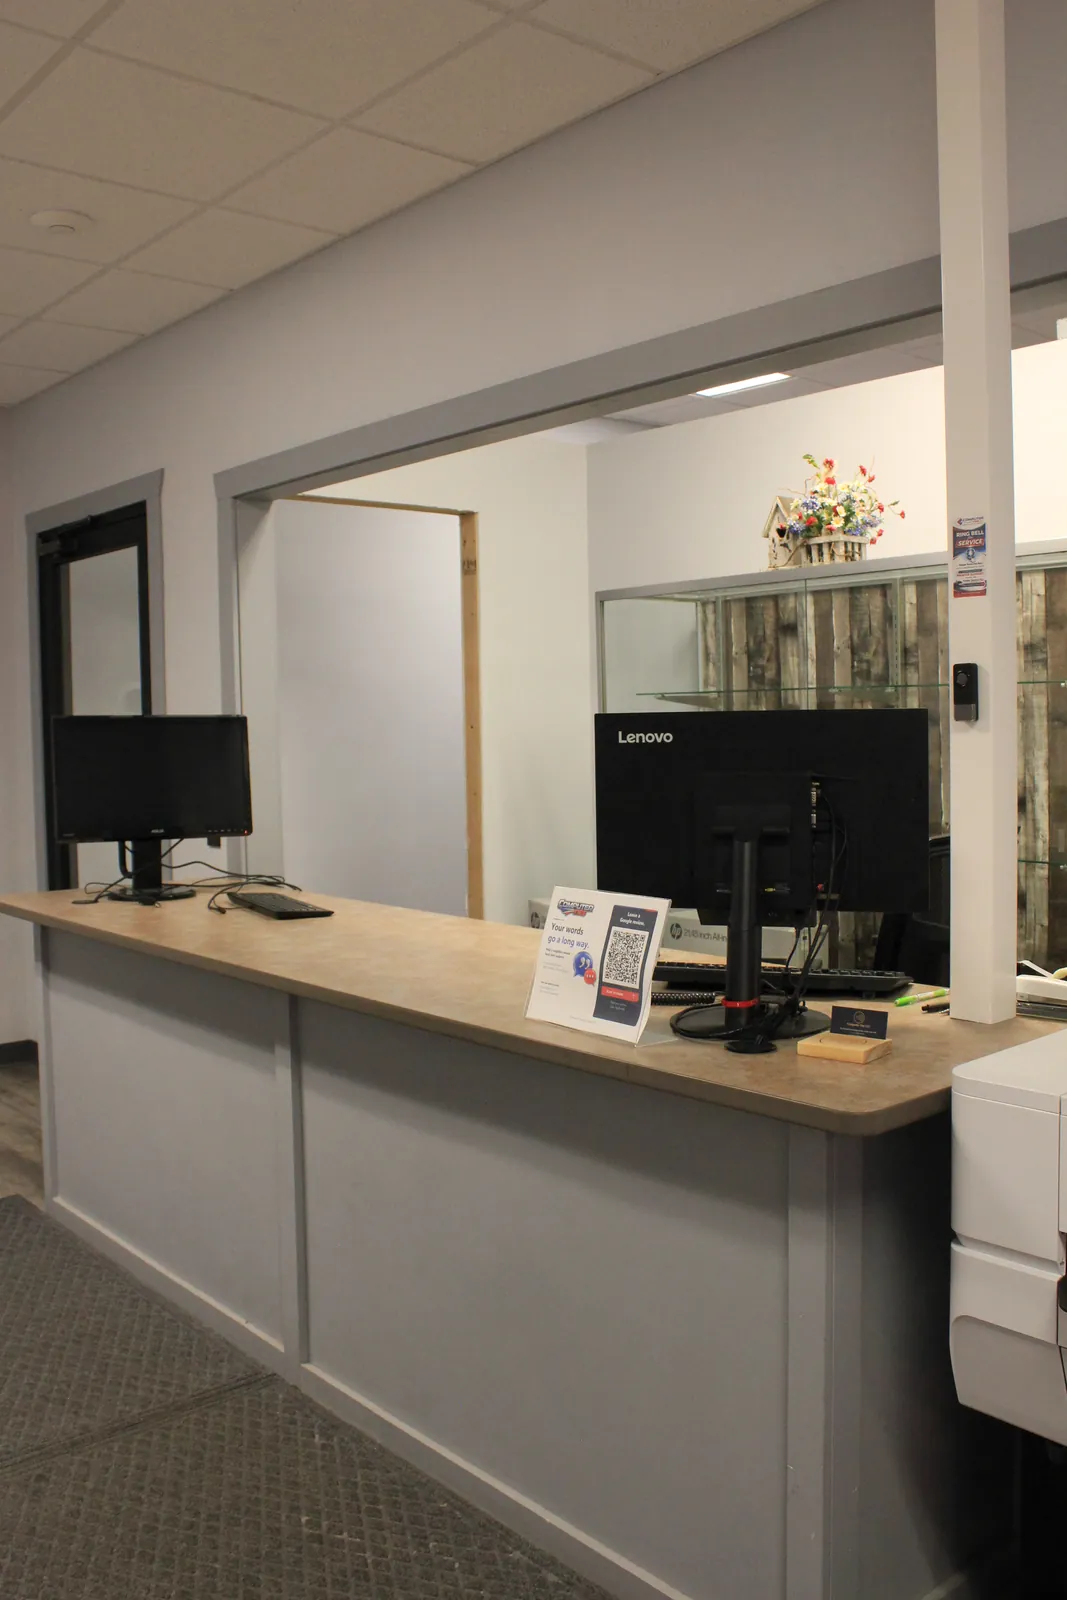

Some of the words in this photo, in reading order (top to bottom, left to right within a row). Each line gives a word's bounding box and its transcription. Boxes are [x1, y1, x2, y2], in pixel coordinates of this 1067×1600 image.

[958, 538, 982, 546] SERVICE
[618, 730, 673, 744] Lenovo
[552, 922, 565, 932] Your
[566, 927, 584, 935] words
[548, 935, 556, 944] go
[561, 936, 575, 948] long
[576, 941, 589, 950] way.
